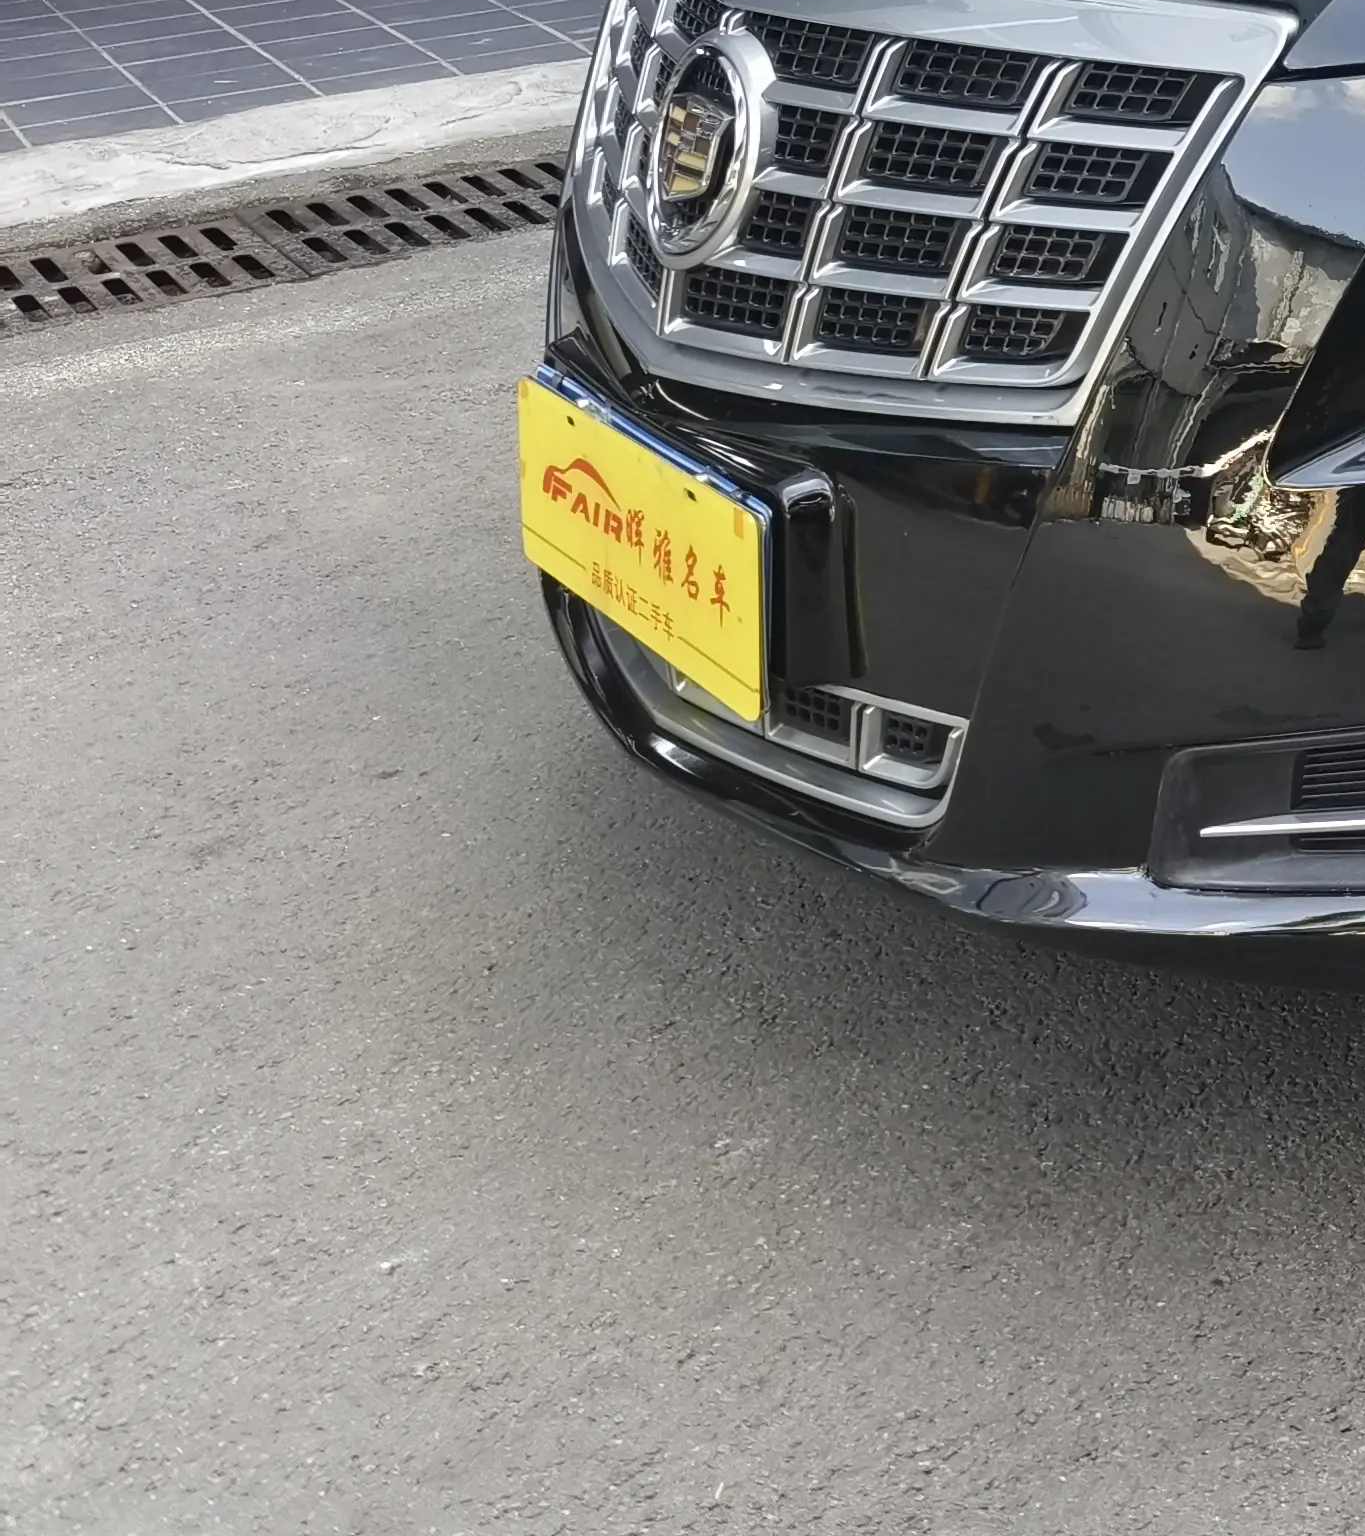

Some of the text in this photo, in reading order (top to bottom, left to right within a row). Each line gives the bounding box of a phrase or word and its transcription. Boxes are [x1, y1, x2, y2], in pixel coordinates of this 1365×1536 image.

[545, 470, 623, 544] FAIR
[591, 560, 676, 642] 品质认证二手车
